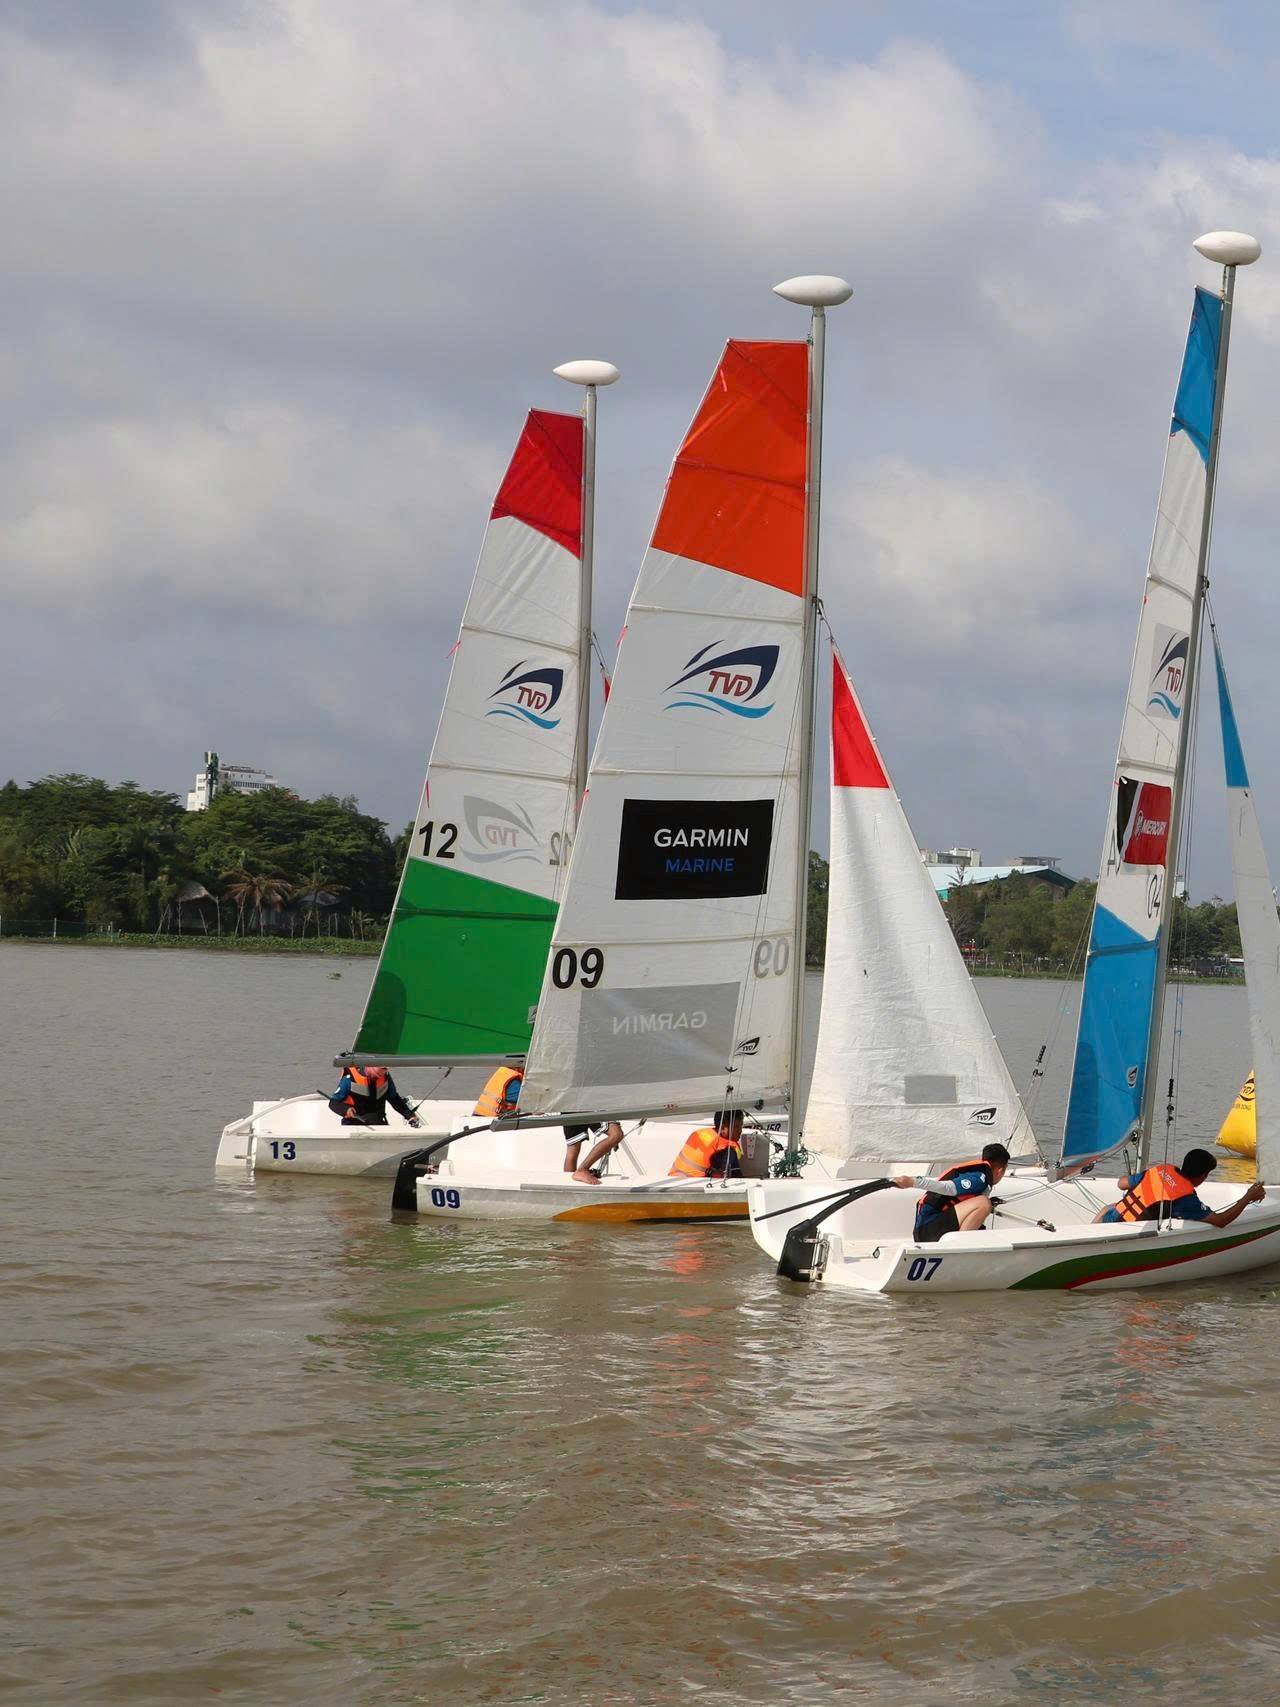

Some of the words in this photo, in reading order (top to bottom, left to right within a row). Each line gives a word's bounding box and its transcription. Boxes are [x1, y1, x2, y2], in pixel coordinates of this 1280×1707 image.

[708, 671, 753, 696] TVD
[1165, 667, 1181, 692] TVD
[517, 686, 547, 709] TVD
[418, 821, 458, 859] 12
[653, 828, 749, 848] GARMIN
[665, 858, 735, 873] MARINE
[552, 948, 604, 989] 09
[270, 1141, 296, 1160] 13
[431, 1188, 461, 1209] 09
[906, 1257, 943, 1282] 07
